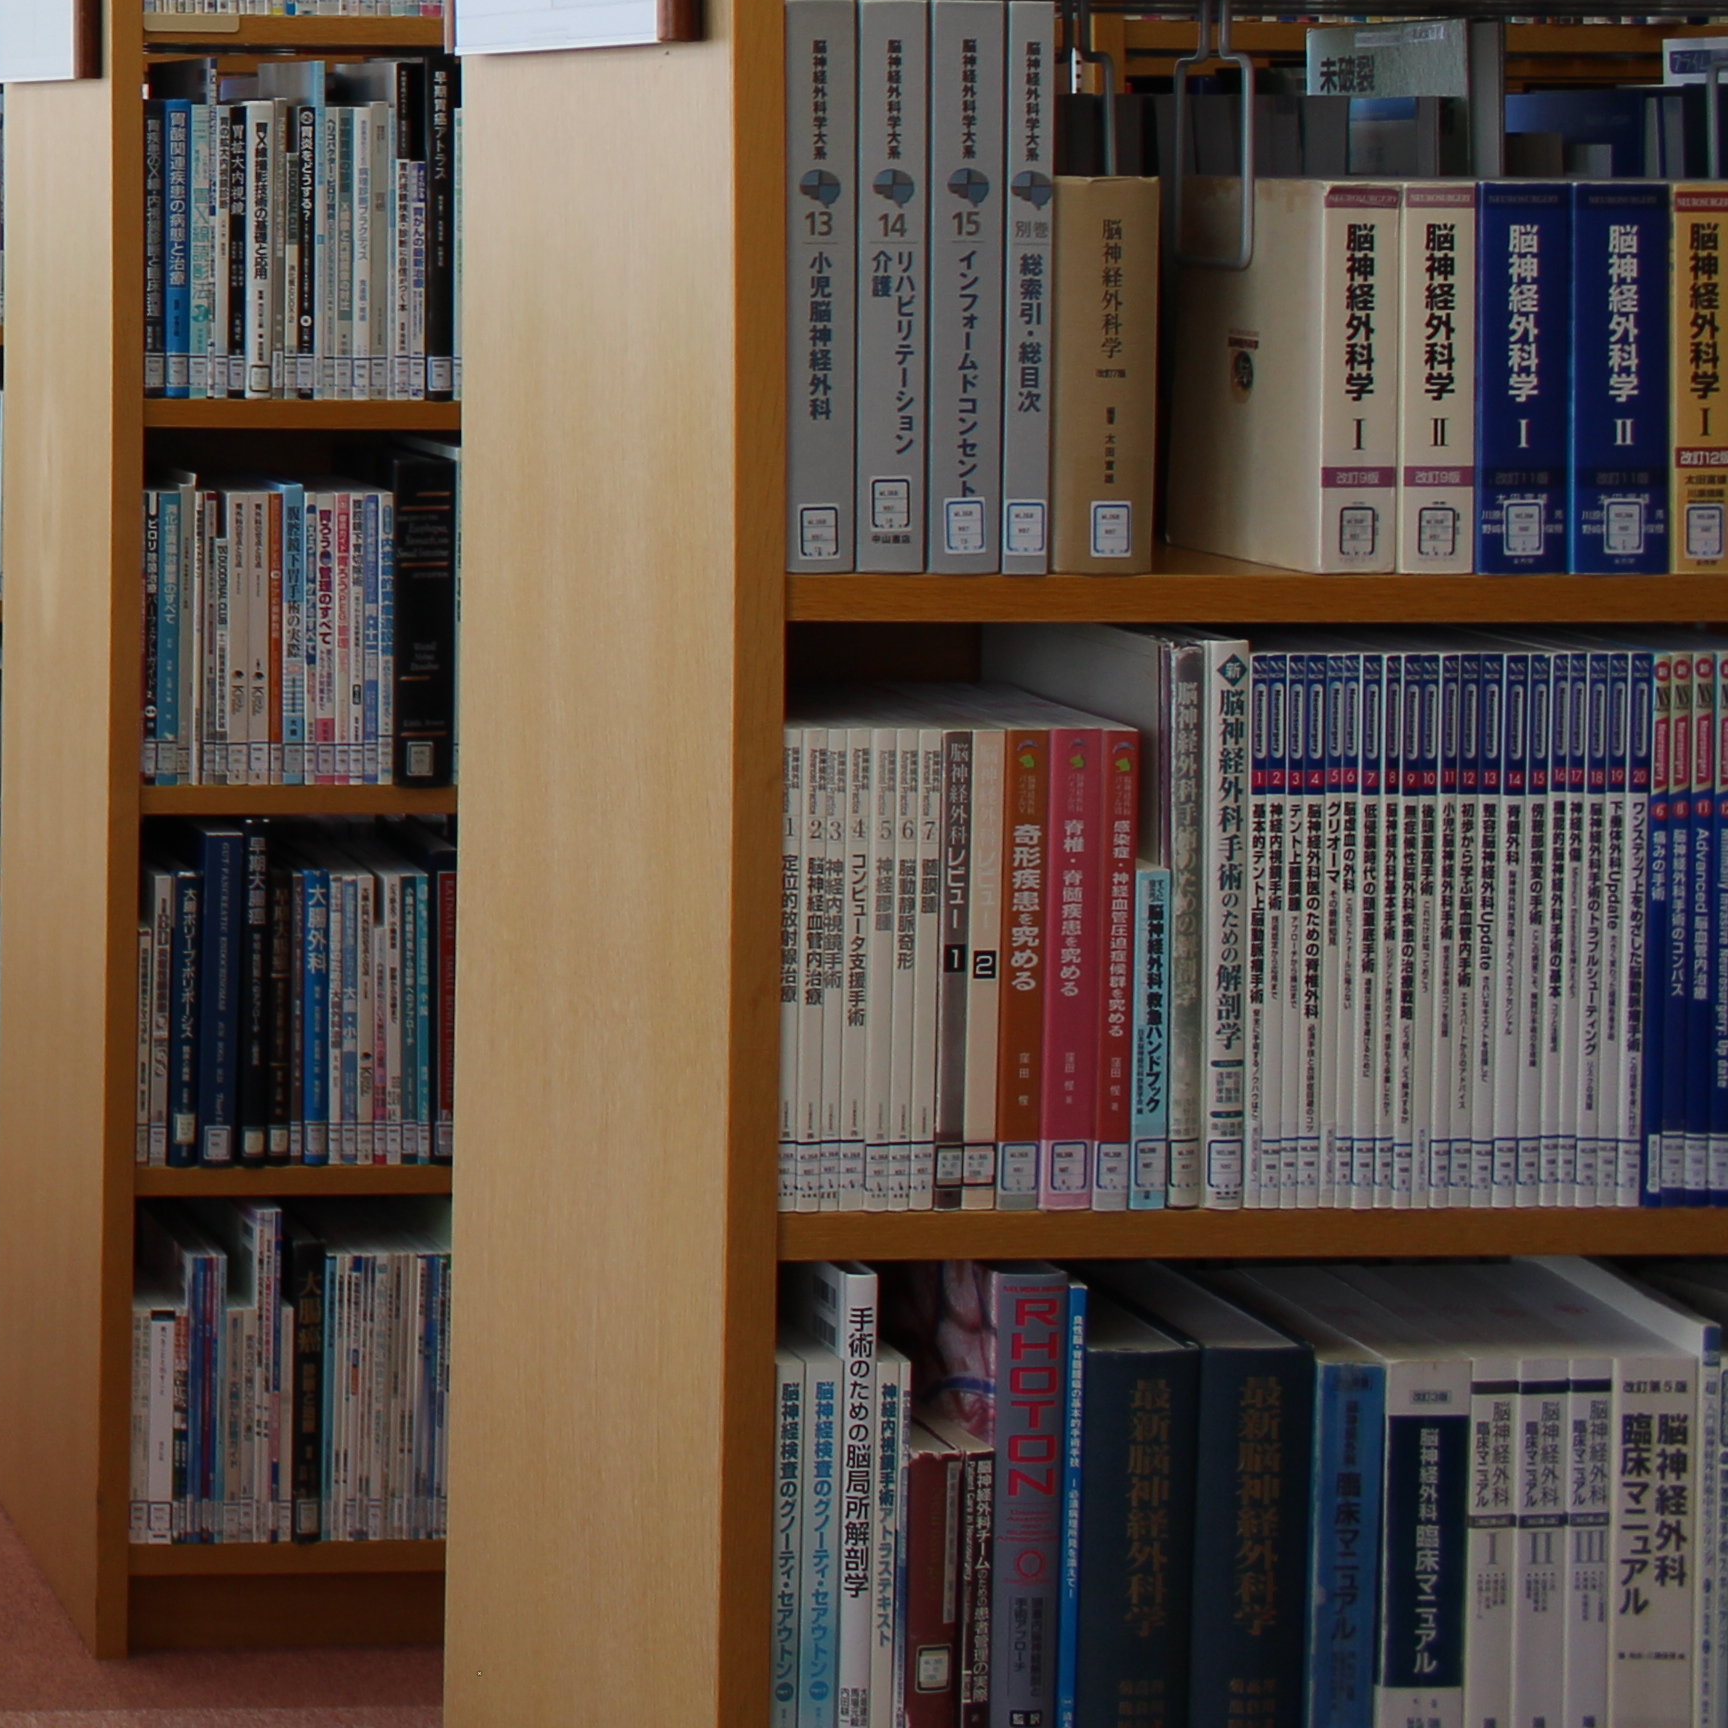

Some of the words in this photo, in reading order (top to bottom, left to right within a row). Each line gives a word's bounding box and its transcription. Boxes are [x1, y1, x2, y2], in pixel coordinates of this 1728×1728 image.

[812, 39, 827, 160] 脳神経外科学大系
[887, 38, 902, 160] 脳神経外科学大系
[962, 38, 977, 159] 脳神経外科学大系
[1025, 42, 1042, 162] 脳神経外科学大系
[804, 211, 833, 236] 13
[871, 250, 892, 298] 介護
[879, 213, 907, 237] 14
[951, 211, 981, 236] 15
[1015, 219, 1050, 238] 別巻
[1101, 219, 1123, 359] 脳神経外科学
[809, 252, 832, 421] 小児脳神経外科
[895, 251, 915, 455] リハビリテーション
[956, 251, 978, 497] インフォームドコンセント
[1017, 253, 1043, 413] 総索引・総目次
[1345, 223, 1375, 402] 脳神経外科学
[1424, 223, 1456, 402] 脳神経外科学
[1507, 224, 1539, 403] 脳神経外科学
[1607, 224, 1640, 403] 脳神経外科学
[1689, 223, 1720, 400] 脳神経外科学
[810, 819, 822, 838] 2
[830, 822, 841, 840] 3
[880, 821, 891, 840] 5
[925, 822, 935, 840] 7
[948, 743, 969, 928] 脳神経外科レビュー
[1214, 690, 1245, 1050] 脳神経外科手術のための解剖学
[1326, 802, 1341, 882] グリオーマ
[308, 885, 327, 974] 大腸外科
[805, 857, 825, 1005] 脳神経血管内治療
[823, 859, 844, 988] 神経内視鏡手術
[848, 854, 867, 1026] コンピュータ支援手術
[975, 954, 994, 976] 2
[1011, 824, 1042, 991] 奇形疾患を究める
[1060, 819, 1084, 997] 脊椎・脊髄疾患を究める
[844, 1305, 875, 1598] 手術のための脳局所解剖学
[1007, 1297, 1059, 1497] RHOTON
[1492, 1401, 1510, 1507] 脳神経外科
[1541, 1401, 1559, 1507] 脳神経外科
[1589, 1400, 1607, 1506] 脳神経外科
[1419, 1429, 1440, 1523] 脳神経外科
[1618, 1413, 1651, 1616] 臨床マニュアル
[1654, 1413, 1688, 1587] 脳神経外科
[1414, 1525, 1441, 1673] 臨床マニュアル
